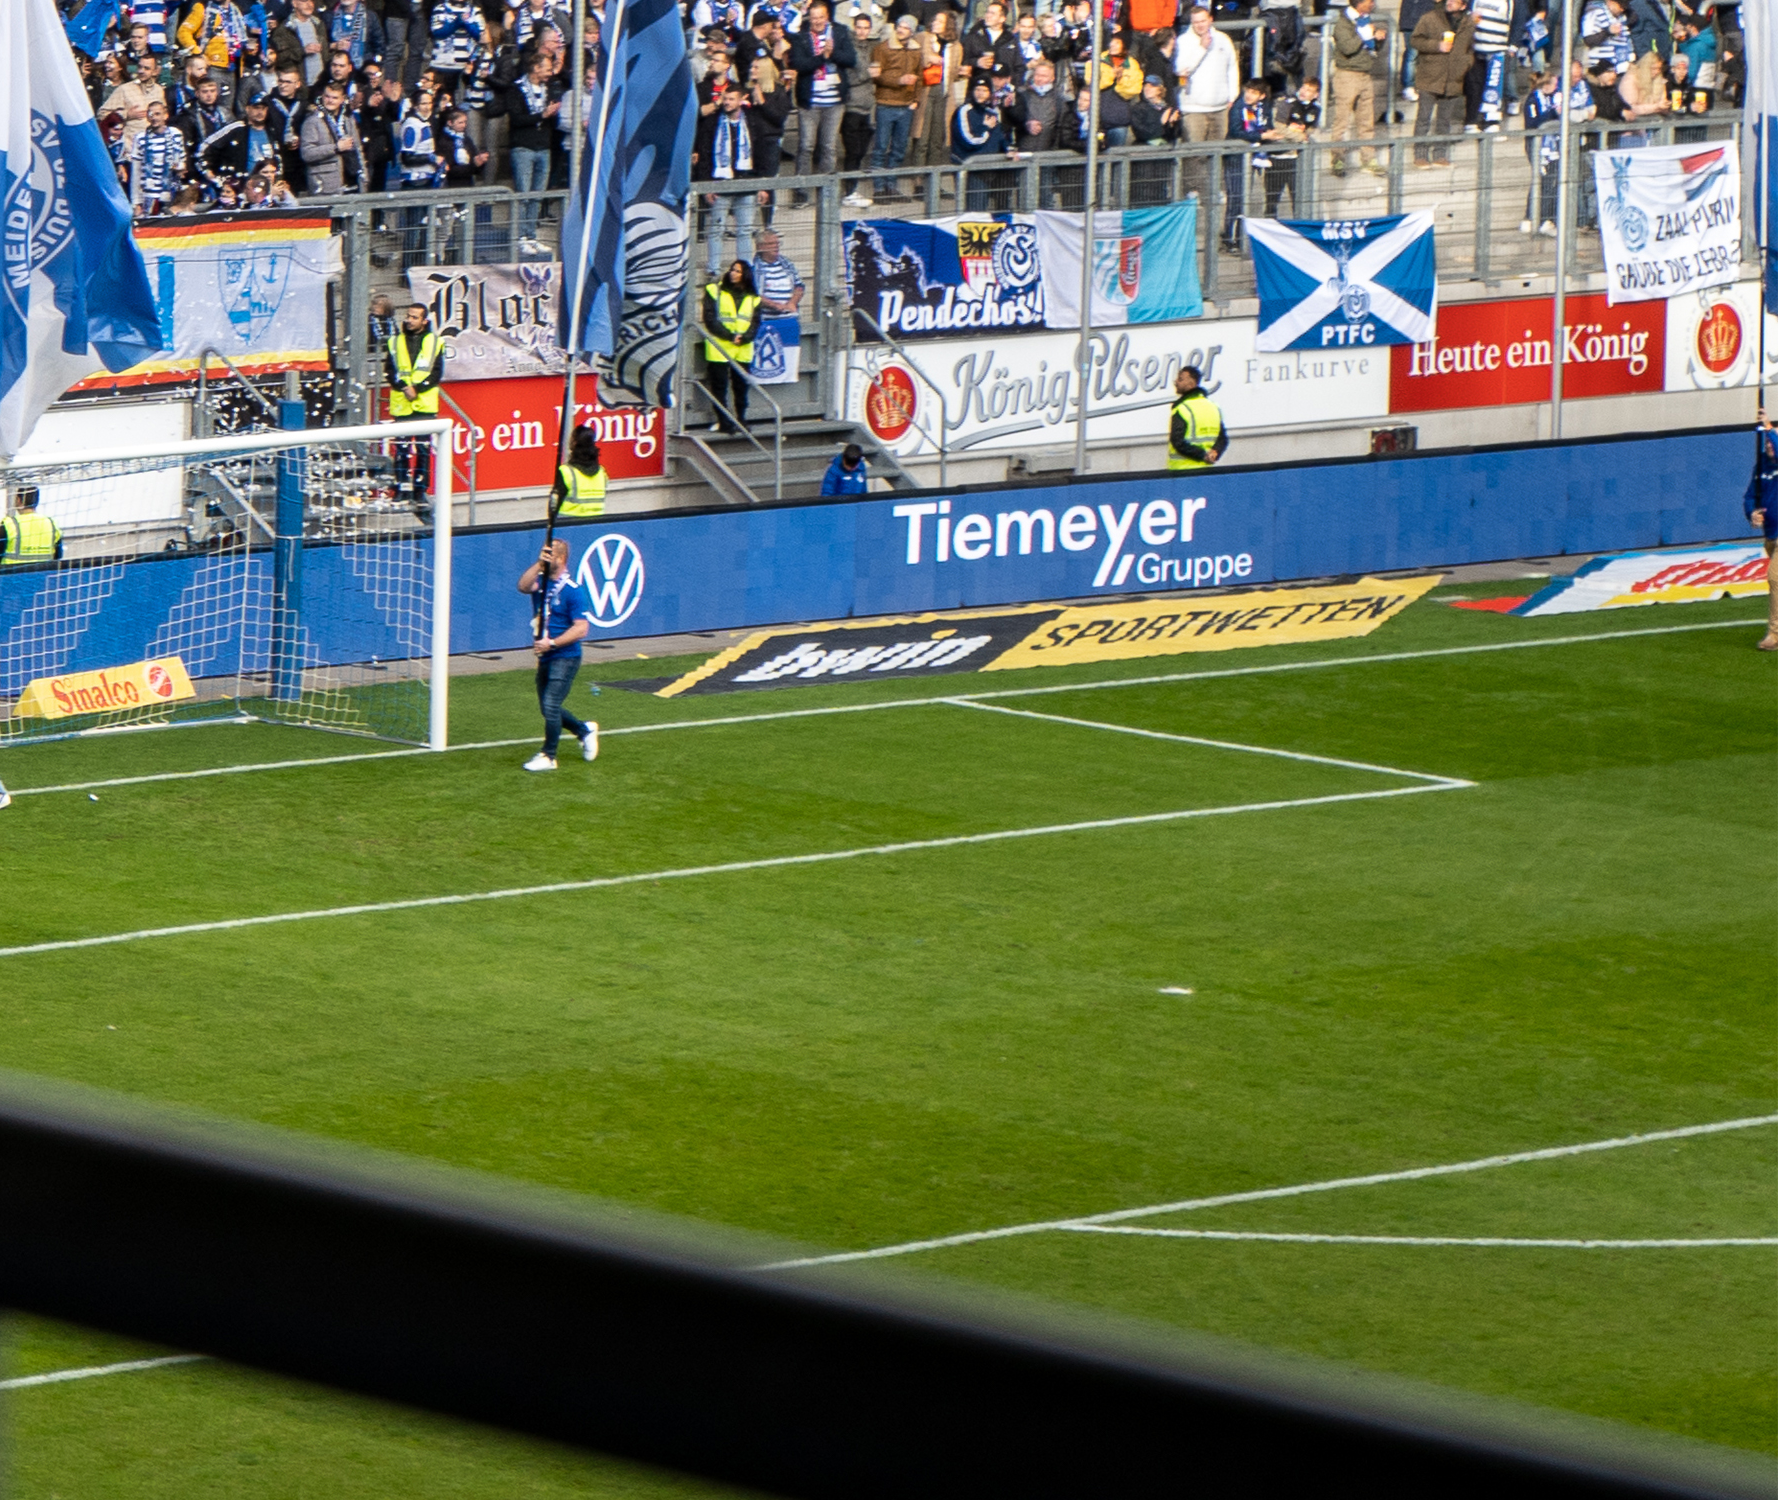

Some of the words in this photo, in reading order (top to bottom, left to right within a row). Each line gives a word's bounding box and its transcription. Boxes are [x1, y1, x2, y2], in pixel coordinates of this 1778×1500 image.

[3, 188, 32, 289] MEIDE
[1322, 222, 1368, 240] MSV
[428, 272, 554, 336] Bloc
[1320, 323, 1376, 346] PTFC
[1408, 336, 1500, 377] Heute
[1505, 330, 1553, 368] ein
[1561, 323, 1649, 375] König
[946, 350, 1071, 426] König
[1244, 354, 1369, 384] Fankurve
[492, 408, 545, 453] ein
[893, 496, 1207, 587] Tiemeyer
[1136, 550, 1253, 587] Gruppe
[1030, 594, 1405, 652] SPORTWETTEN
[732, 628, 994, 684] bwin
[51, 673, 139, 714] Sinalco
